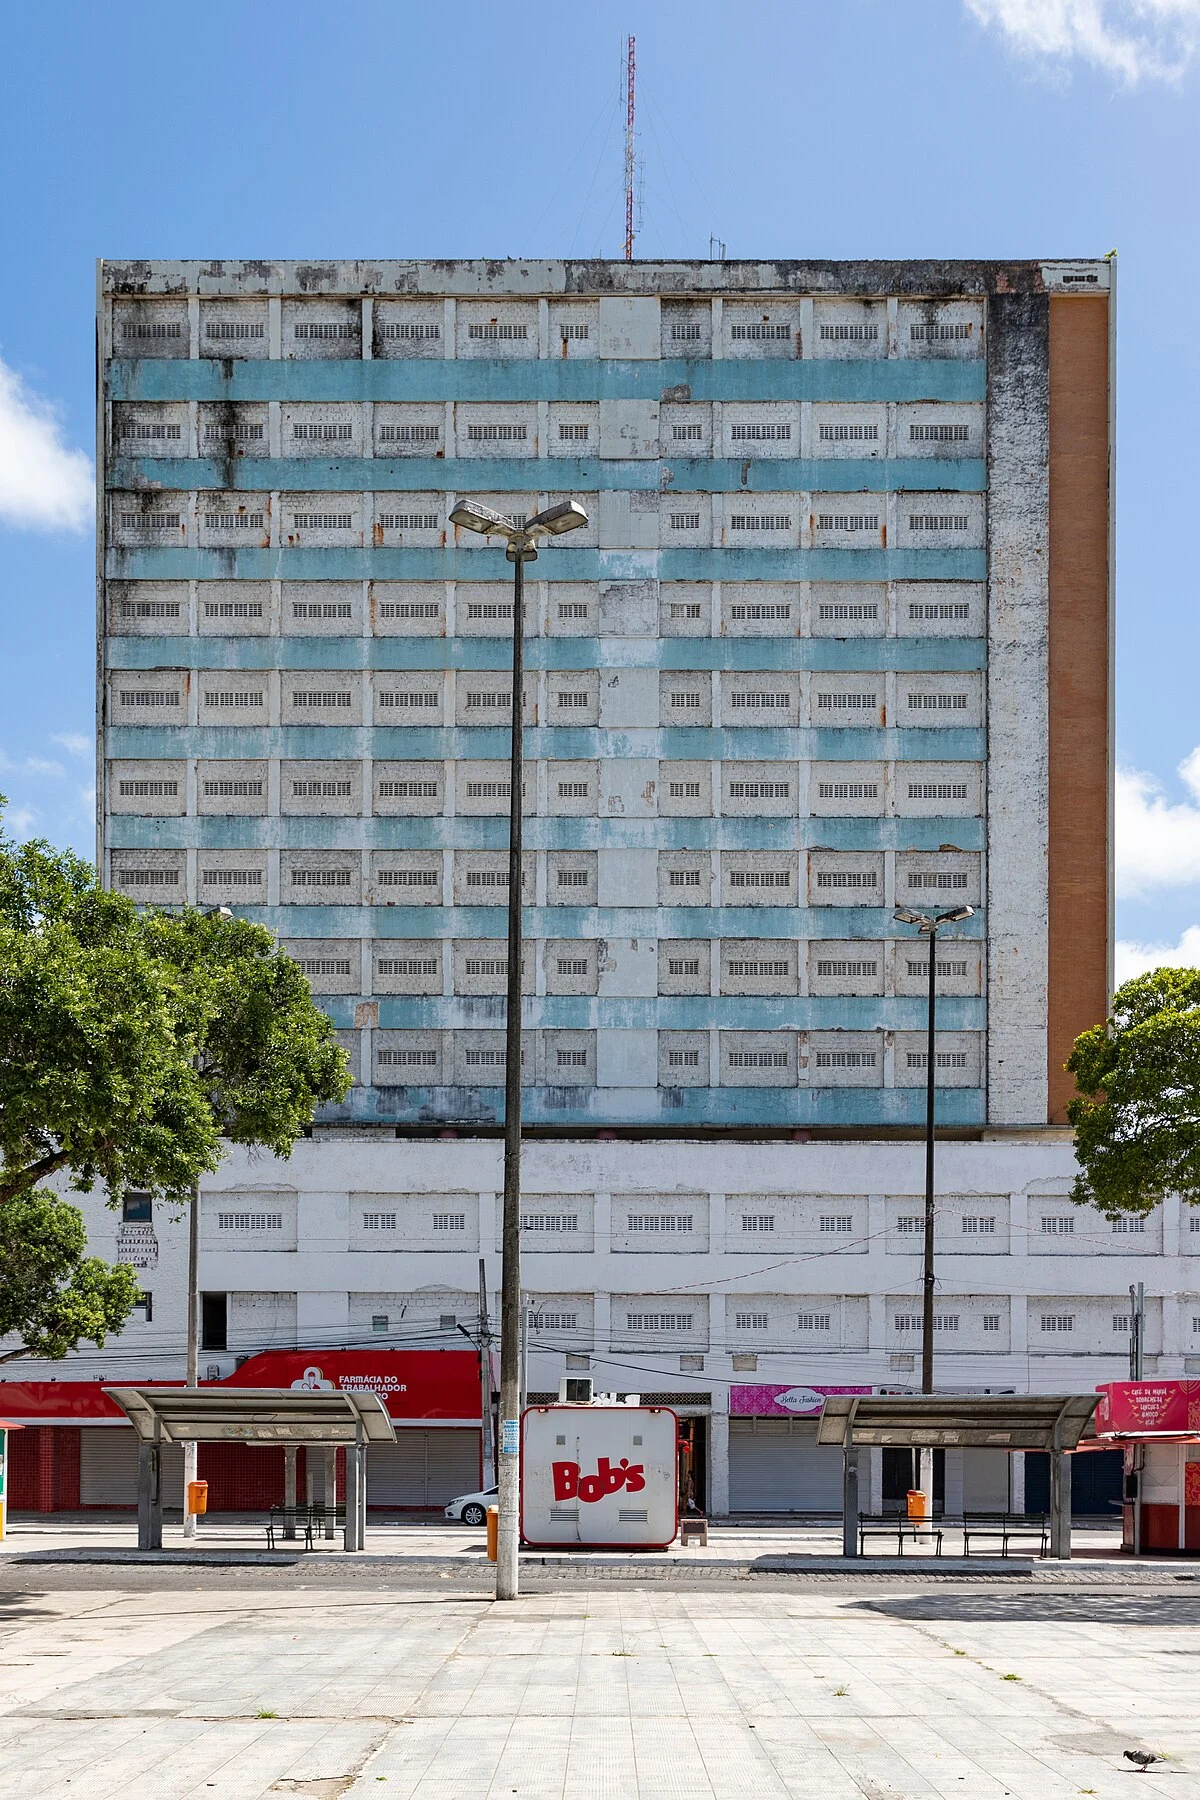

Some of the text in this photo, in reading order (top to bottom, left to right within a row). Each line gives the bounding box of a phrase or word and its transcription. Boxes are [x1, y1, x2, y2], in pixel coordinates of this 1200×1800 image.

[339, 1375, 398, 1384] FARMÁCIA DO
[340, 1384, 407, 1392] TRABALHADOR
[780, 1395, 798, 1405] Bella
[551, 1456, 647, 1504] Bob's
